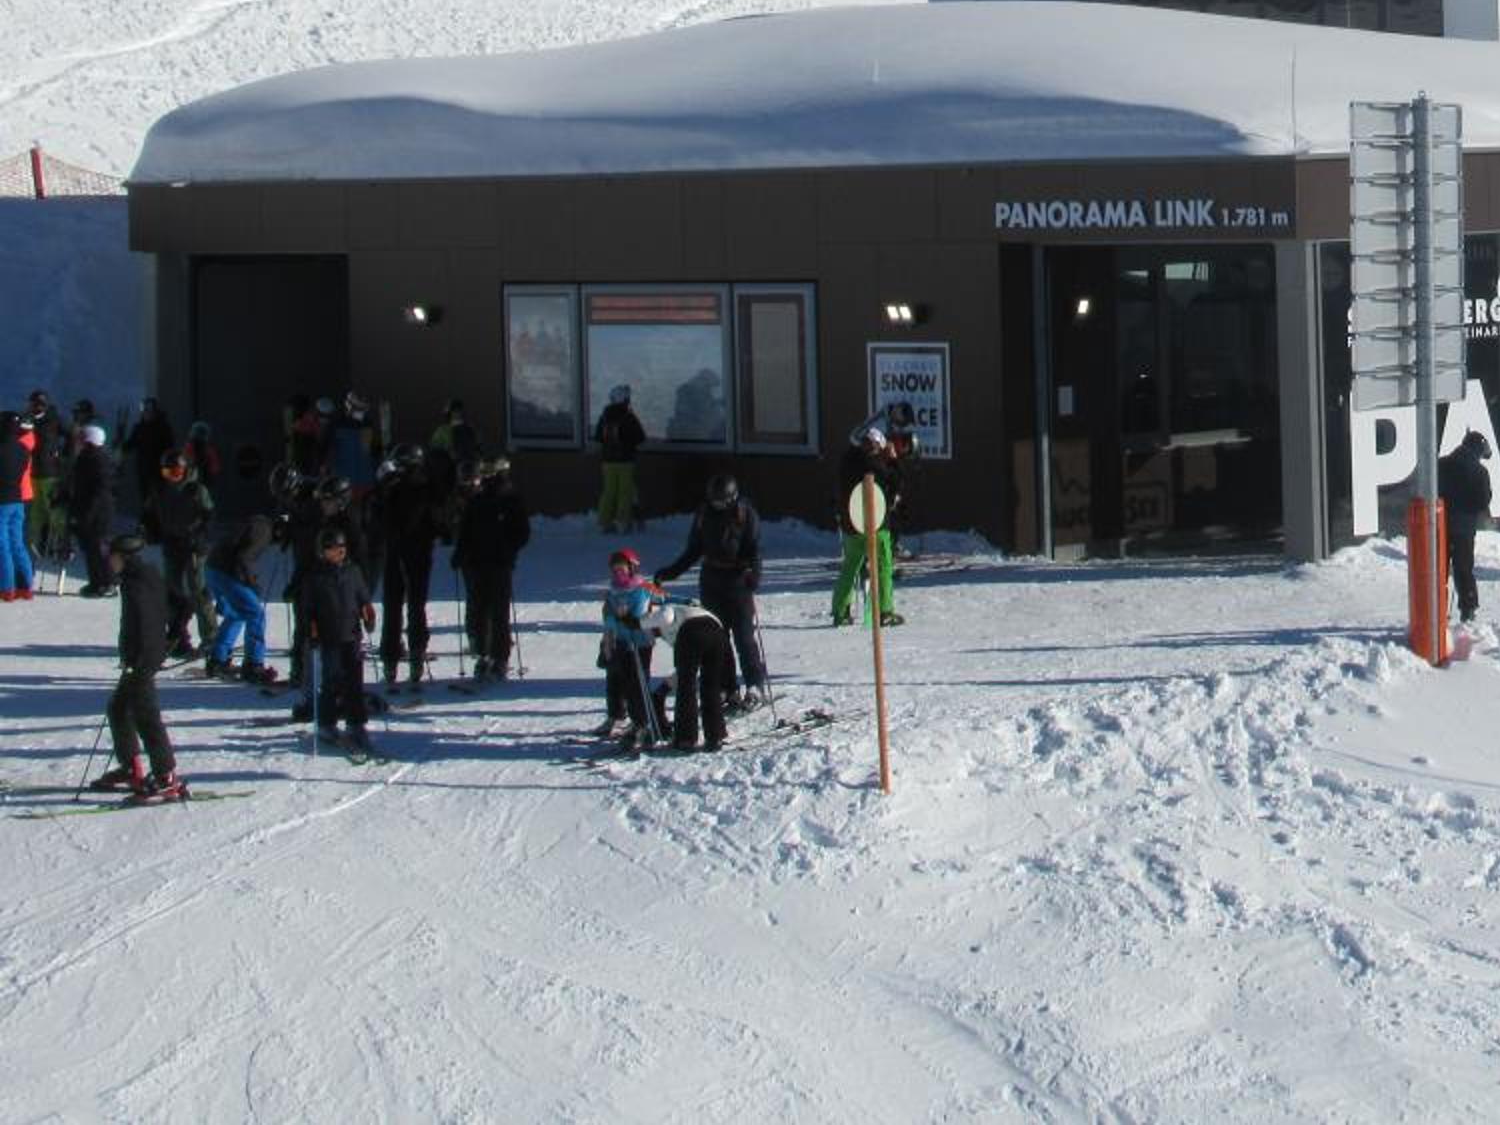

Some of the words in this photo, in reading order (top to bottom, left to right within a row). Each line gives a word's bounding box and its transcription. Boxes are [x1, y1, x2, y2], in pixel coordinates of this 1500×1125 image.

[994, 200, 1148, 228] PANORAMA
[1154, 199, 1215, 226] LINK
[1220, 207, 1265, 227] 1.781
[1271, 210, 1289, 226] m
[881, 372, 937, 393] SNOW
